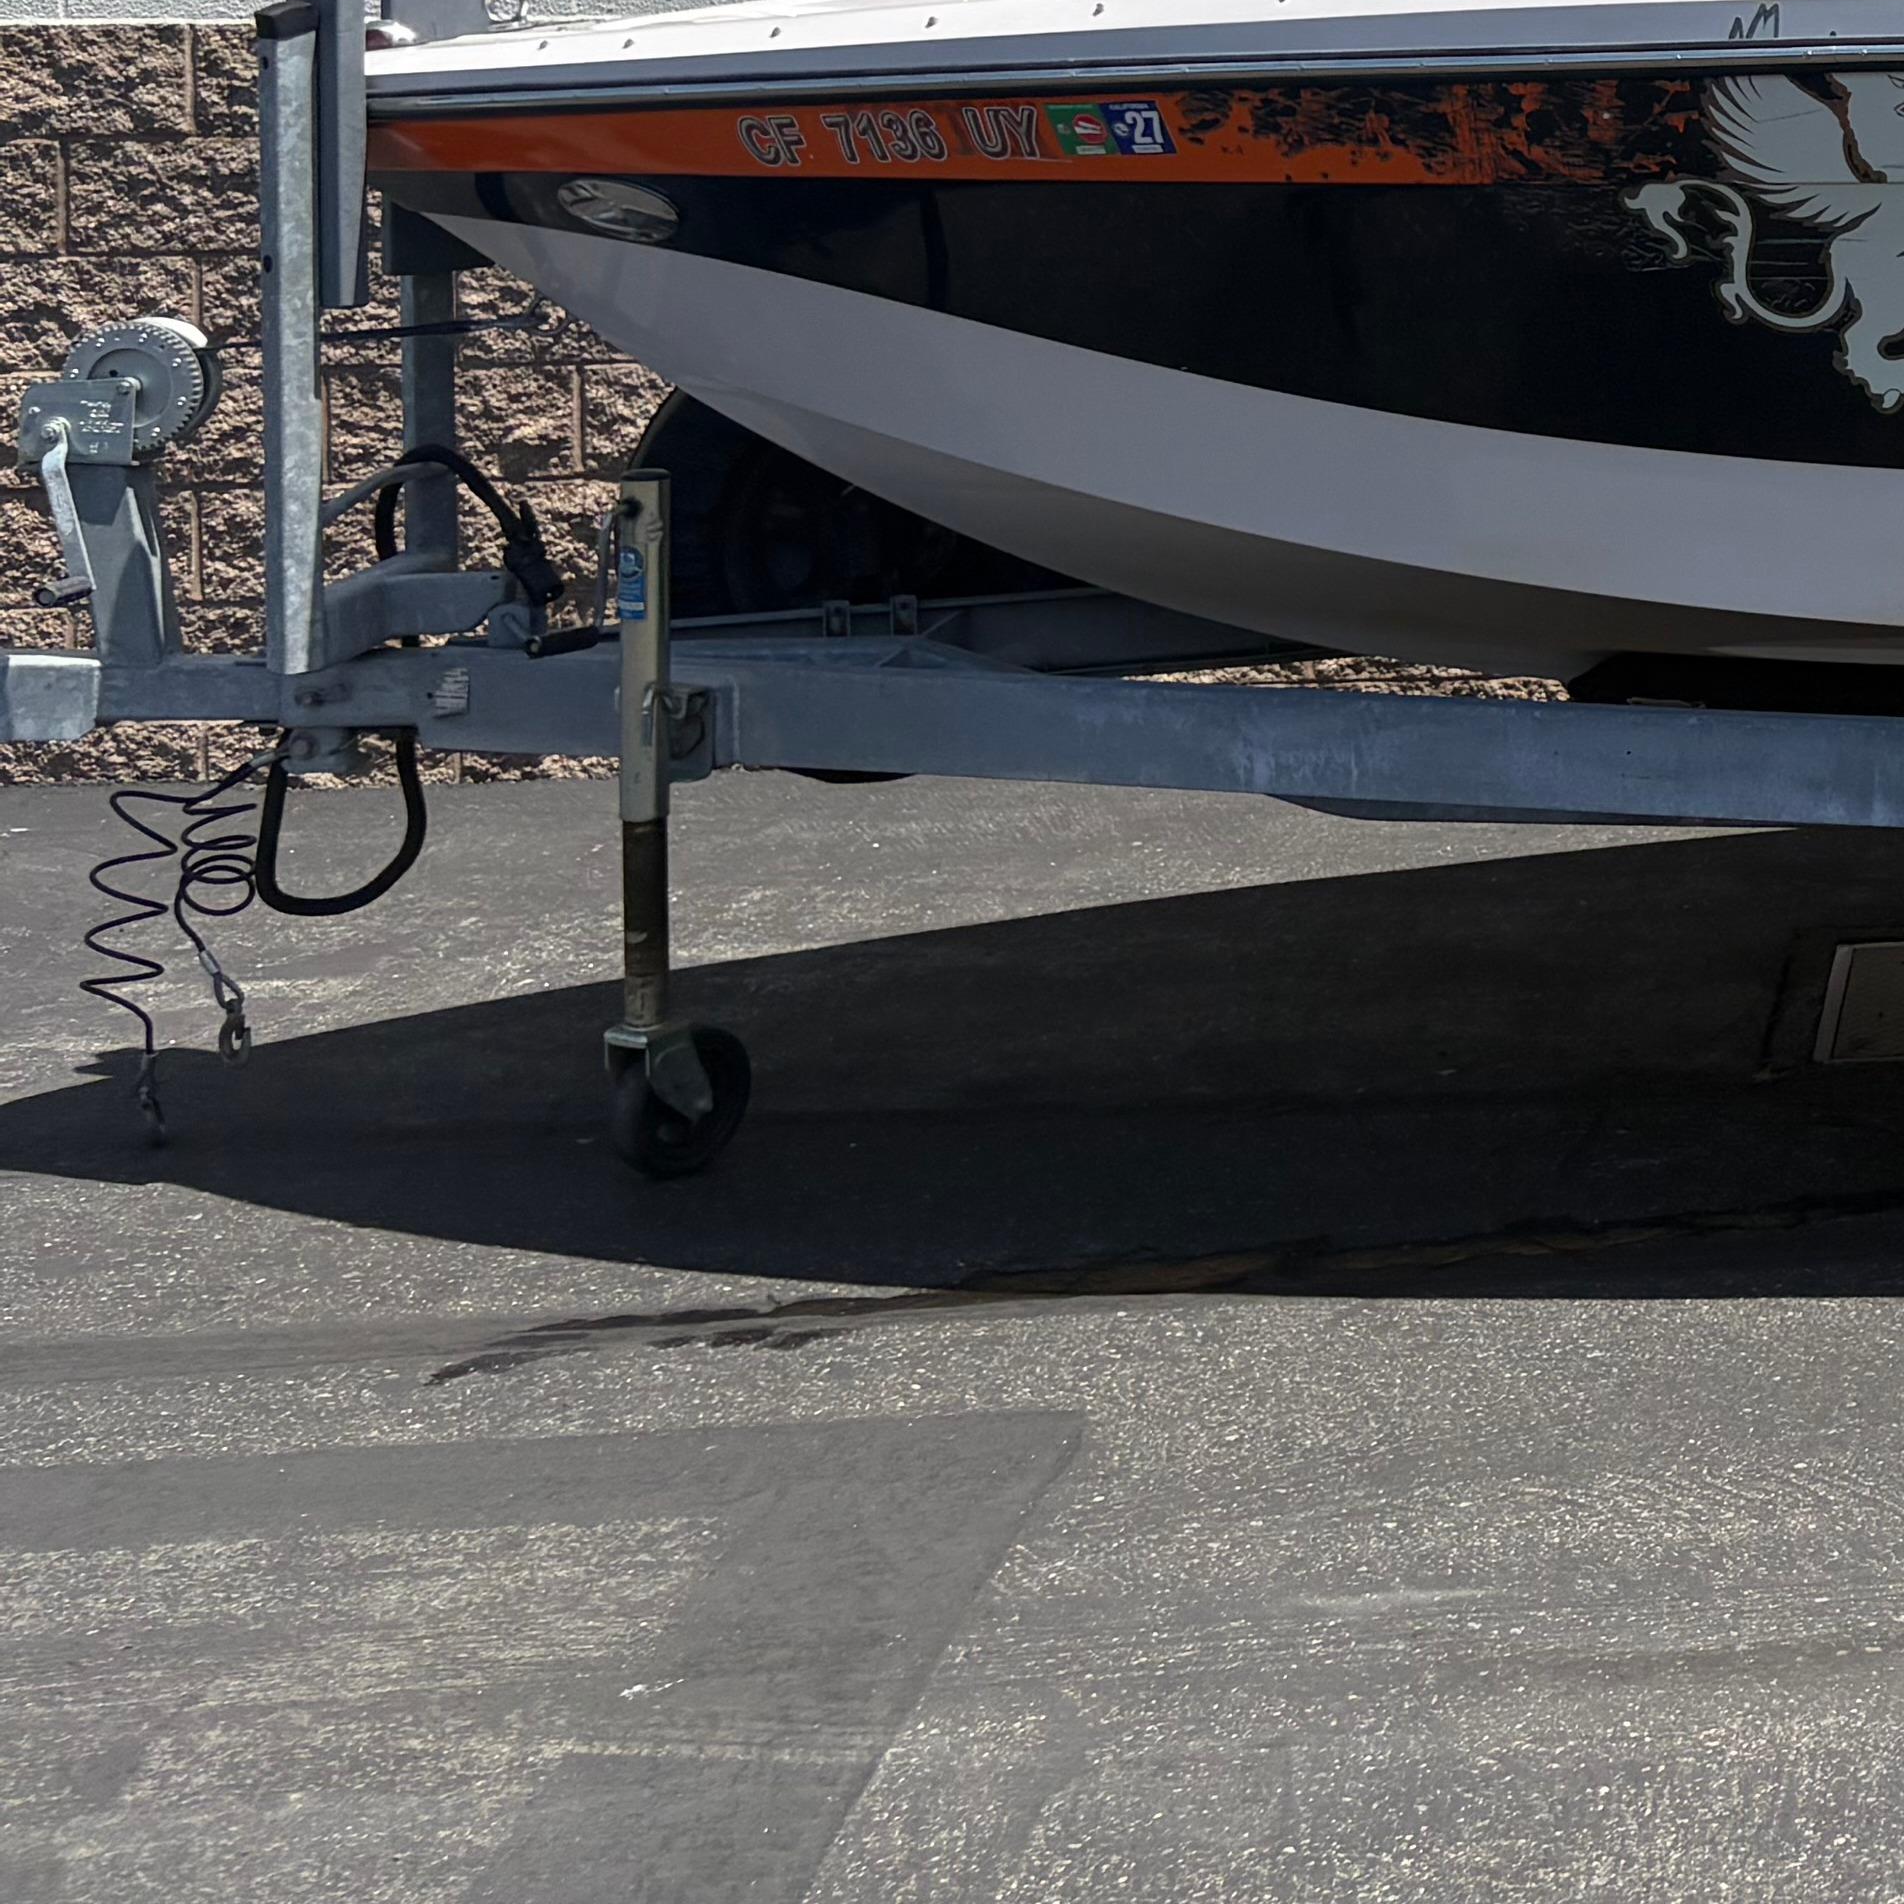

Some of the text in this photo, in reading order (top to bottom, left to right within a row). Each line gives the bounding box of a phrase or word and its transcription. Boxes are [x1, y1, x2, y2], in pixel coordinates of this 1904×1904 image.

[738, 106, 1040, 167] CF 7136 UY
[1124, 110, 1165, 145] 27
